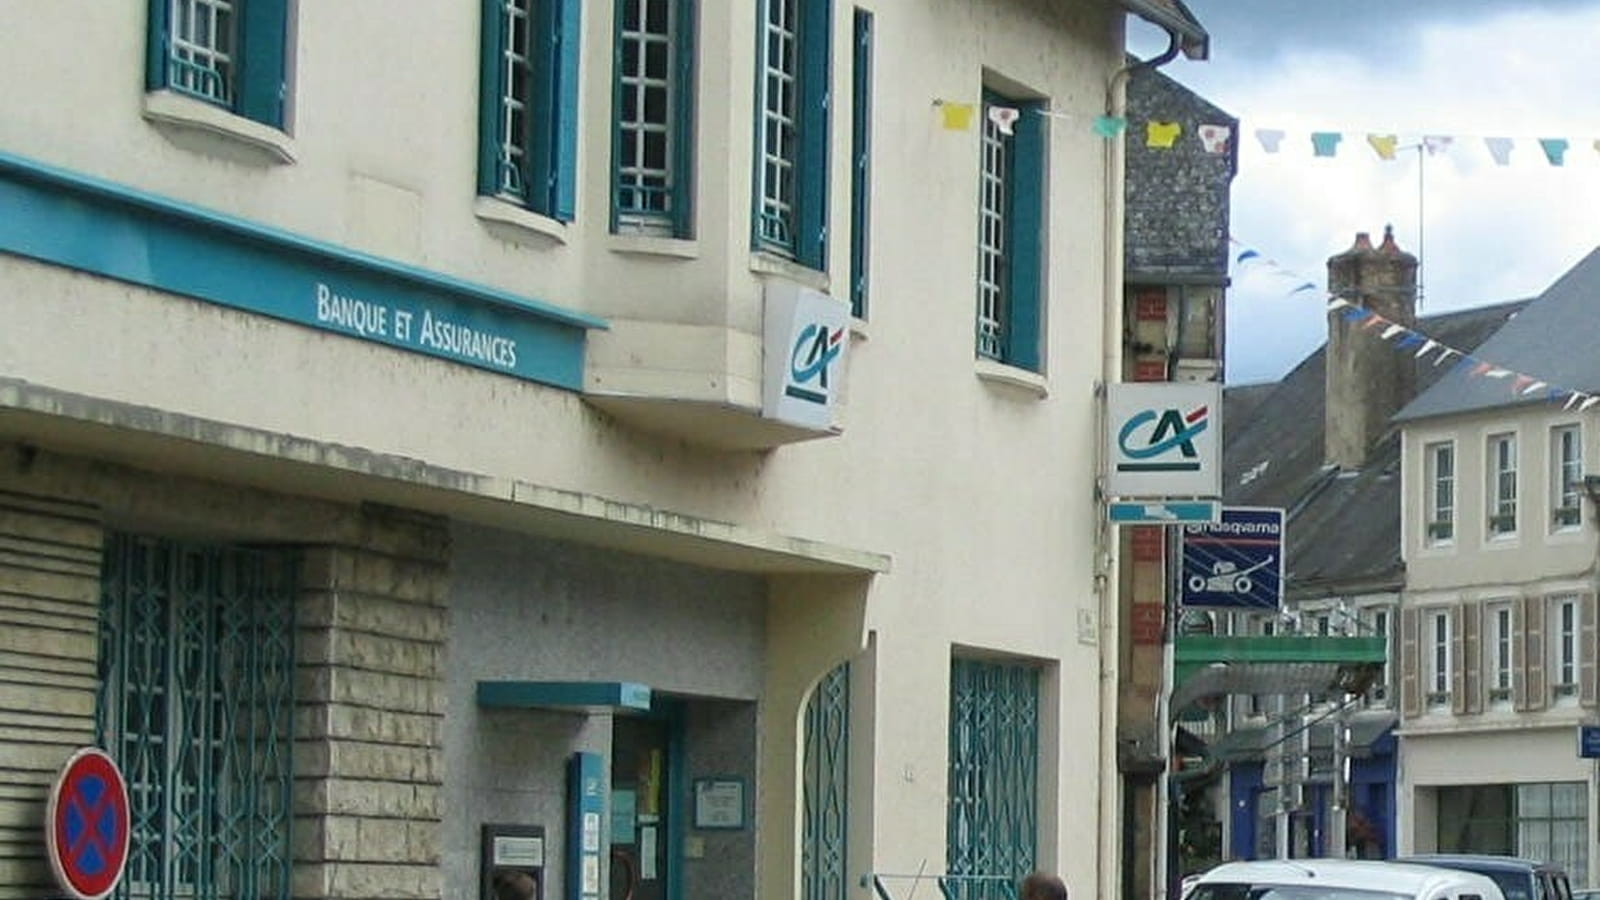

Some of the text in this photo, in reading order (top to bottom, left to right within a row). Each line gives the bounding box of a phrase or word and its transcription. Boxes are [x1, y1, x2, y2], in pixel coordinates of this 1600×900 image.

[317, 283, 516, 367] BANQUE ET ASSURANCES
[791, 324, 841, 388] CA
[1118, 407, 1208, 459] CA
